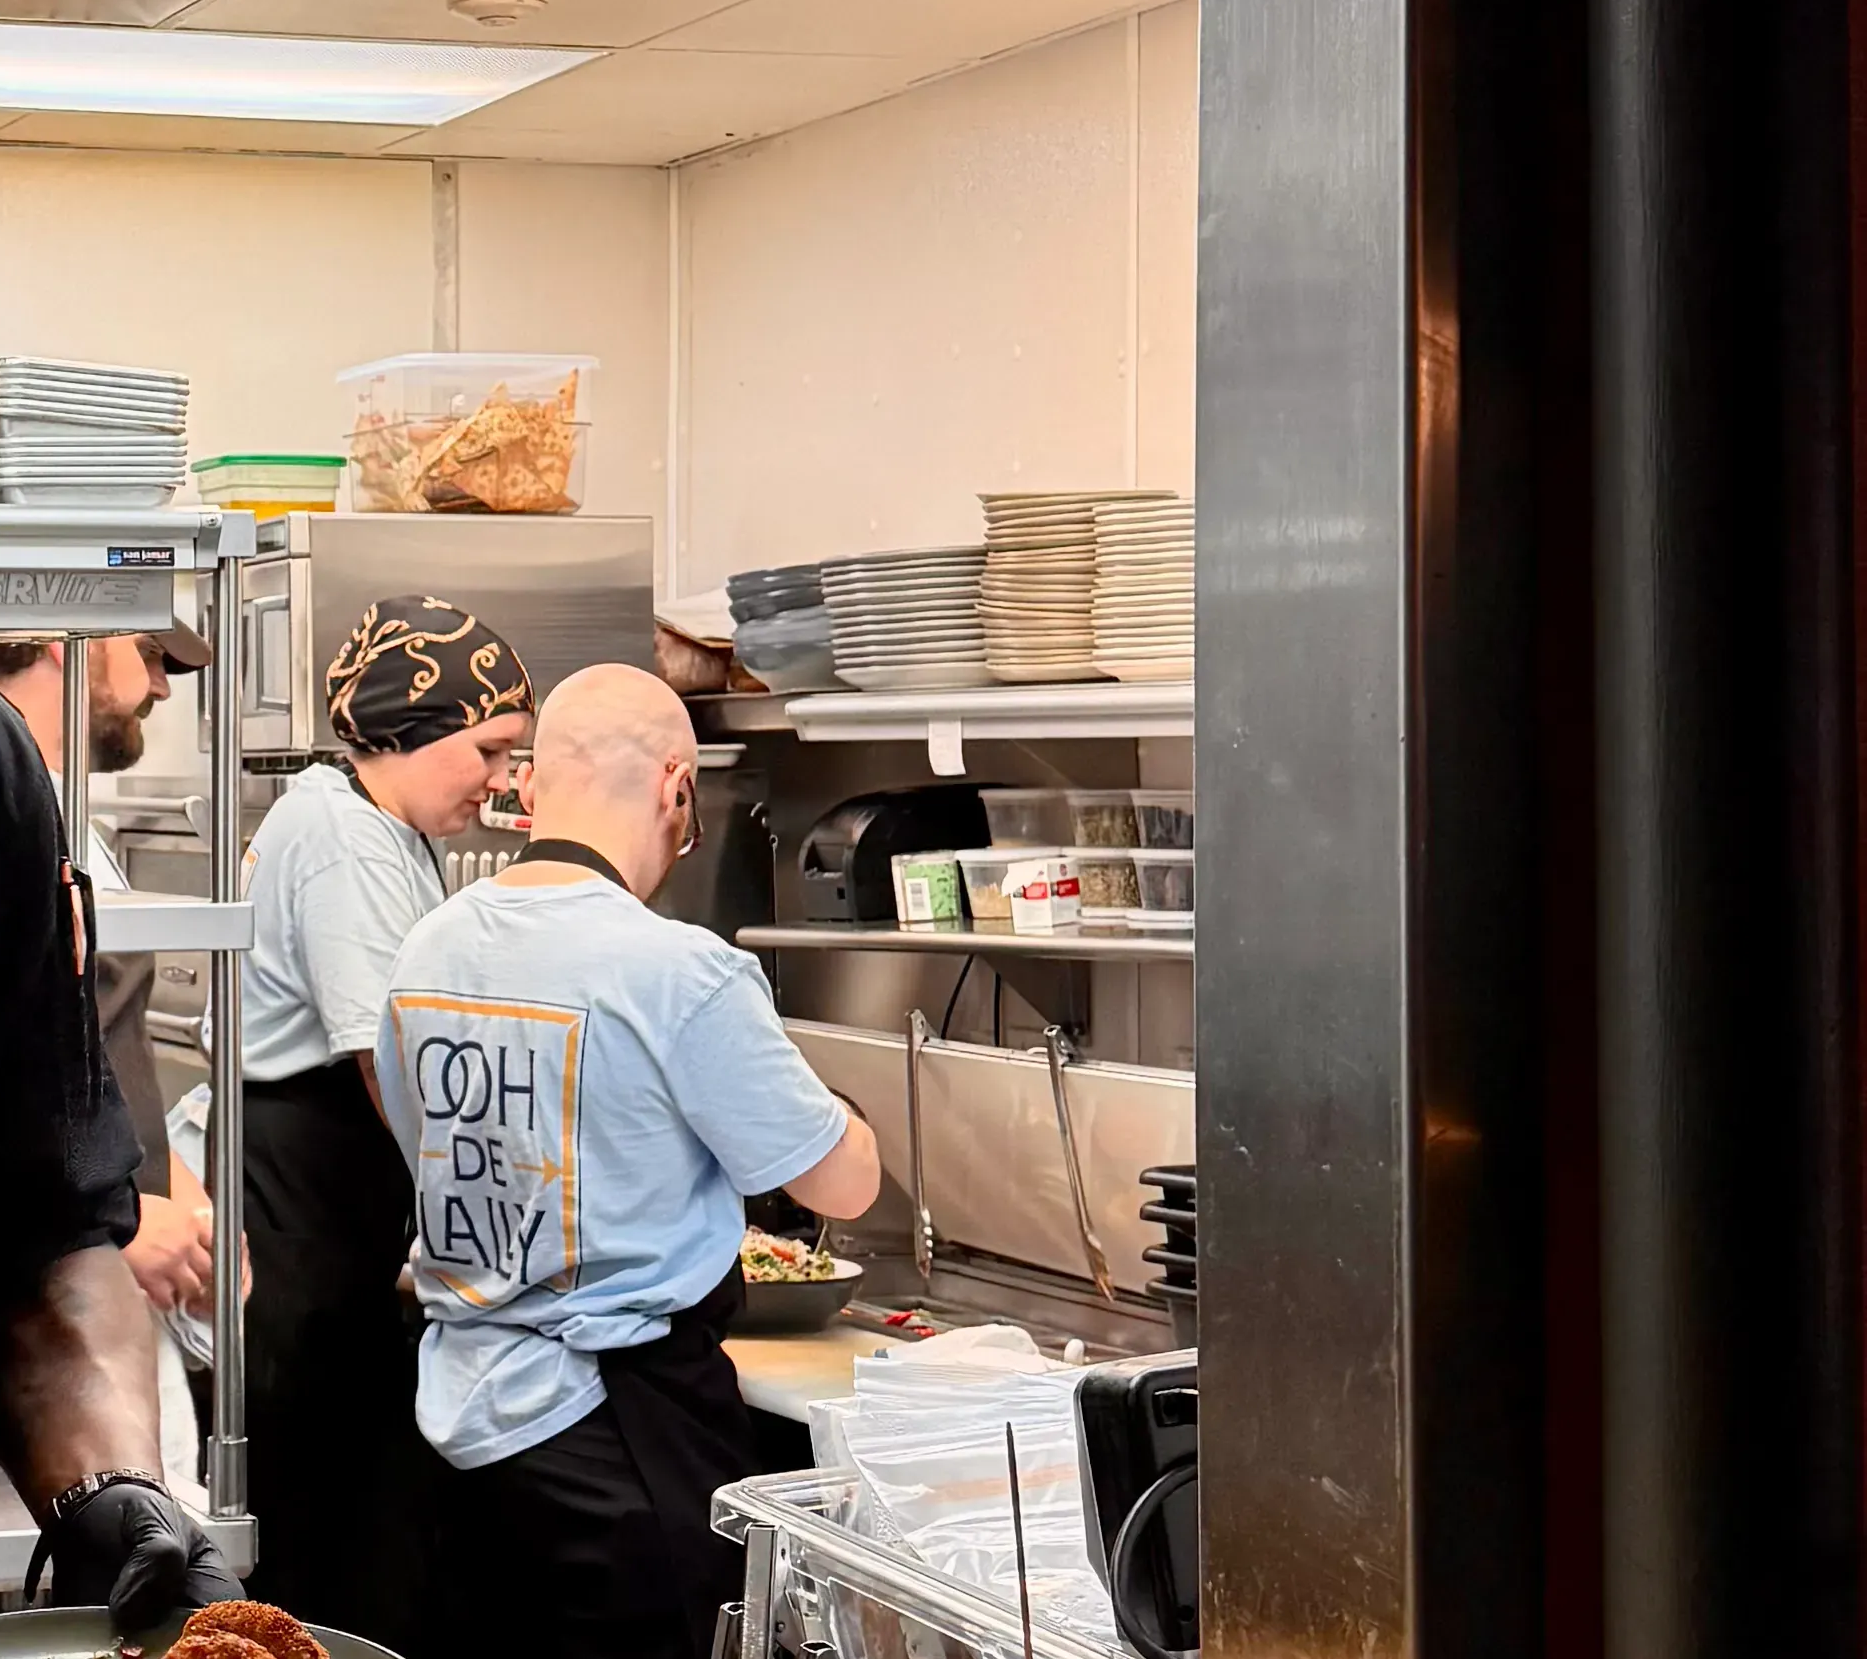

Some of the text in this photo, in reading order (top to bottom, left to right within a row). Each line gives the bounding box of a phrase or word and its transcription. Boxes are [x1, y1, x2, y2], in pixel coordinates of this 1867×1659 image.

[417, 1037, 535, 1131] OOH
[452, 1135, 507, 1187] DE
[420, 1191, 546, 1285] LALLY
